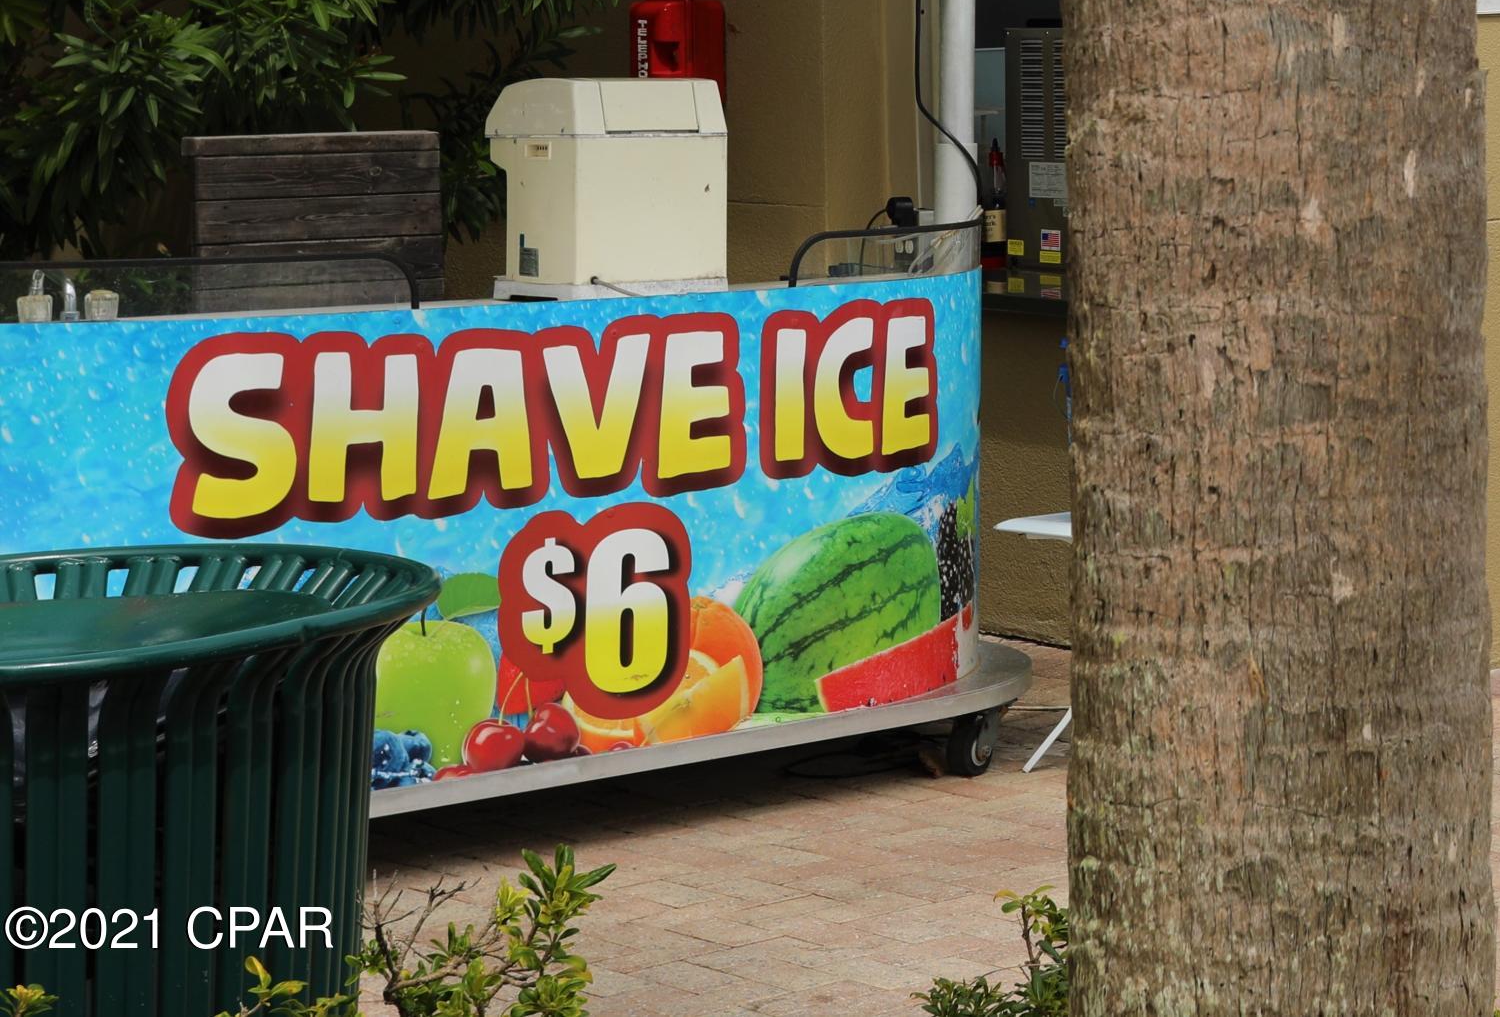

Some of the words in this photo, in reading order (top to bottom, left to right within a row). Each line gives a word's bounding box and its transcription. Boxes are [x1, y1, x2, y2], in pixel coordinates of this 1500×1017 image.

[181, 324, 737, 524] SHAVE
[770, 310, 934, 468] ICE
[518, 524, 677, 698] $6
